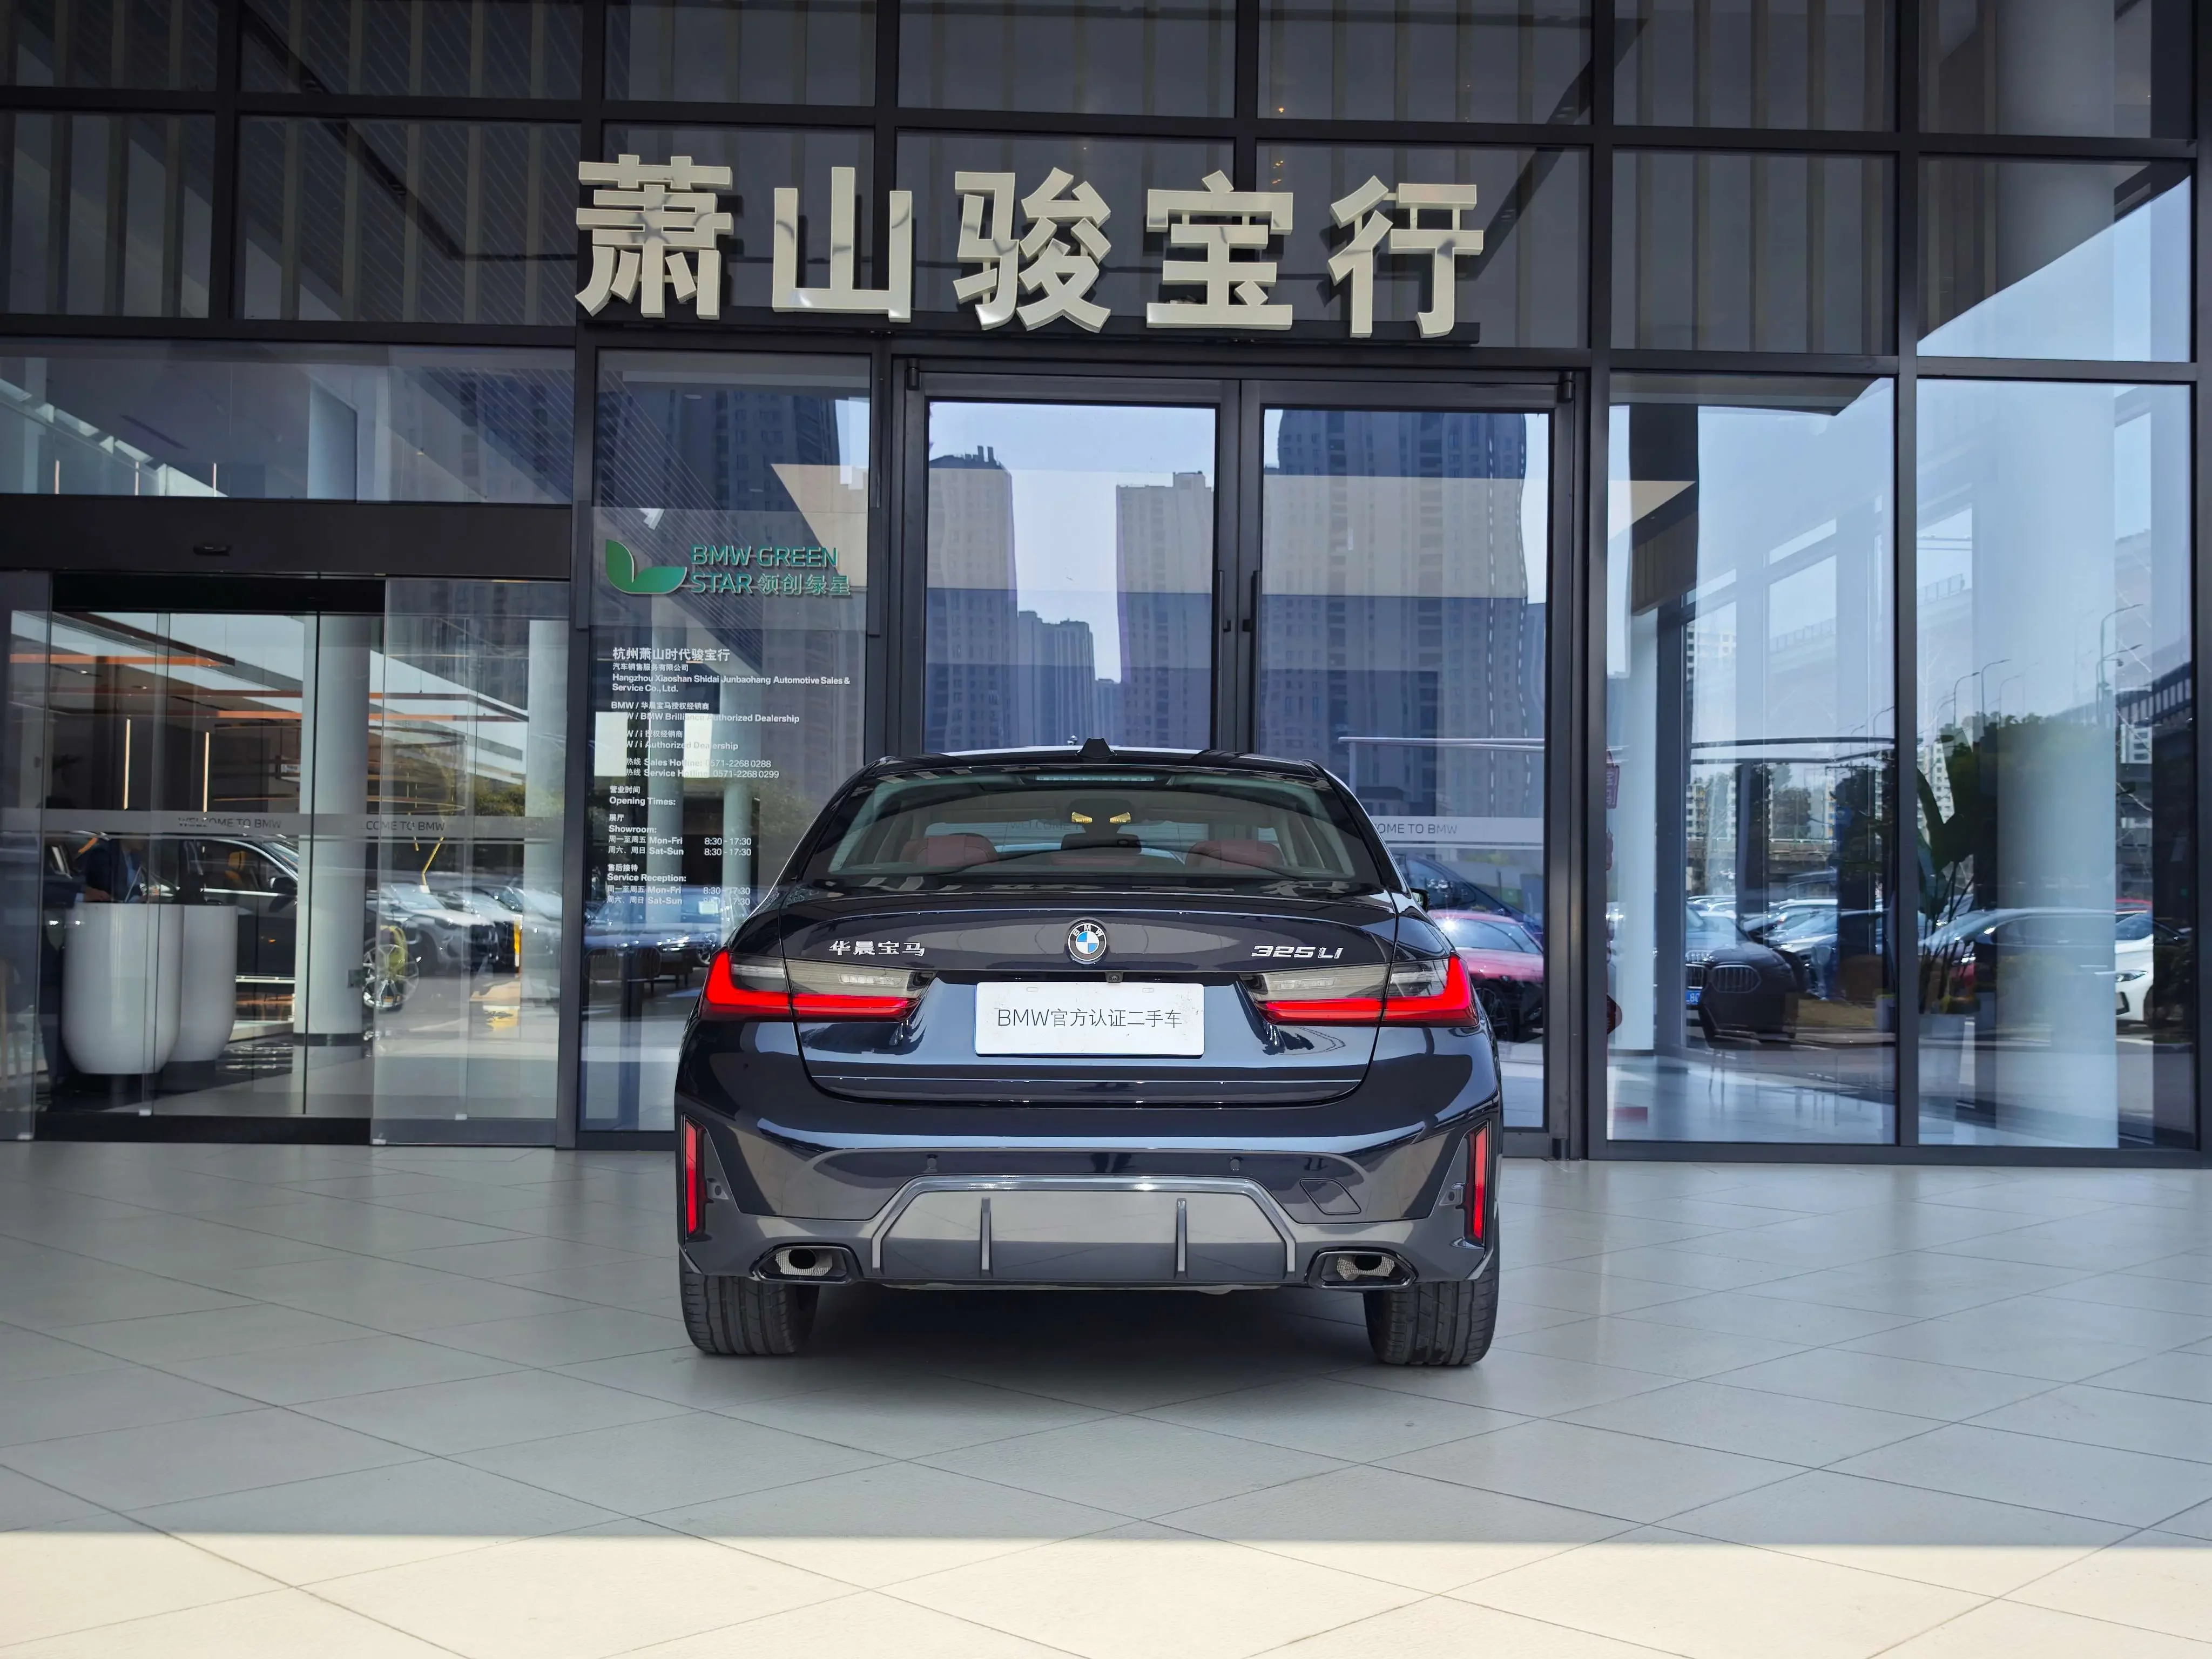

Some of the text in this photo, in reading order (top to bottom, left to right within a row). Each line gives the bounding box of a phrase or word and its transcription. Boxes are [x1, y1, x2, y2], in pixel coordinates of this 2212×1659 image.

[575, 154, 1483, 339] 萧山骏宝行
[691, 544, 838, 567] BMW GREEN
[691, 572, 852, 595] STAR 领创绿星
[612, 647, 731, 662] 杭州萧山时代骏宝行
[612, 663, 689, 672] 汽车销售服务有限公司
[612, 674, 653, 683] Hangzhou
[655, 675, 692, 683] Xiaoshan
[694, 675, 720, 683] Shidai
[721, 676, 771, 685] Junbaohang
[773, 676, 820, 684] Automotive
[612, 684, 644, 692] Service
[645, 685, 662, 693] Co.,
[641, 702, 710, 711] 华晨宝马授权经销商
[640, 712, 664, 720] BMW
[707, 713, 753, 722] Authorized
[755, 714, 800, 724] Dealership
[645, 730, 683, 738] 授权经销商
[645, 740, 692, 749] Authorized
[693, 741, 739, 751] Deaership
[644, 758, 668, 766] Sales
[644, 769, 676, 777] Service
[610, 785, 640, 794] 营业时间
[609, 796, 676, 806] Opening Times:
[609, 814, 624, 822] 展厅
[237, 819, 251, 827] TO
[255, 819, 281, 828] BMW
[399, 821, 415, 831] TO
[419, 822, 445, 831] BMW
[609, 825, 657, 833] Showroom:
[1407, 824, 1424, 834] TO
[1428, 824, 1457, 834] BMW
[608, 835, 646, 844] 周一至周五
[649, 837, 683, 845] Mon-Fri
[704, 837, 723, 845] 8:30
[730, 838, 752, 846] 17:30
[649, 847, 684, 855] Sat-Sun
[704, 848, 722, 856] 8:30
[608, 864, 638, 872] 售后接待
[607, 873, 686, 883] Service Reception:
[607, 885, 645, 893] 周一至周五
[648, 886, 682, 894] Mon-Fri
[648, 896, 683, 905] Sat-Sun
[1072, 924, 1104, 938] BMW
[828, 940, 926, 957] 华晨宝马
[997, 1008, 1183, 1028] BMW官方认证二手车
